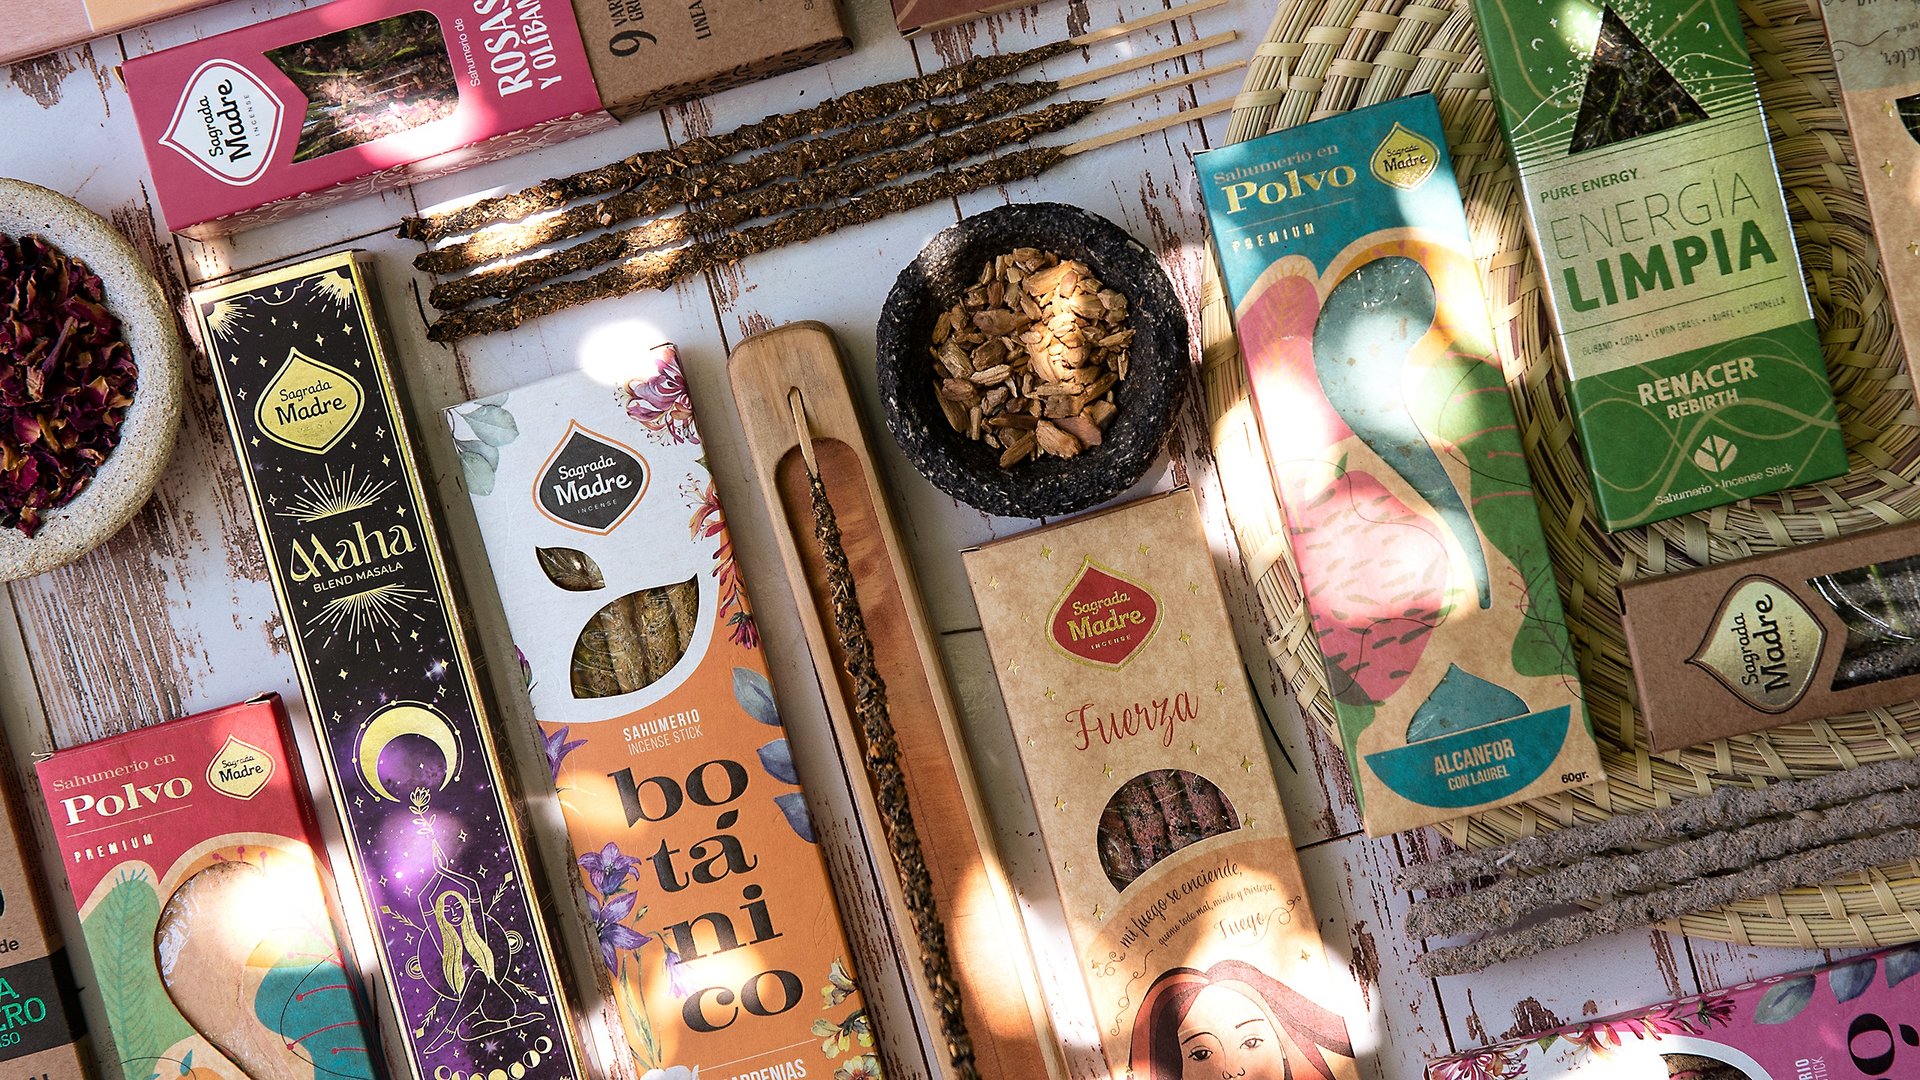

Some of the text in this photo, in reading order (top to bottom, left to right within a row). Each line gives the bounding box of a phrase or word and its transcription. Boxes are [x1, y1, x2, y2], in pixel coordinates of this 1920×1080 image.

[454, 17, 480, 87] Sahumerio de
[473, 0, 533, 98] ROSAS
[609, 30, 657, 57] 9
[538, 75, 562, 91] Y
[197, 95, 224, 157] Sagrada
[217, 79, 252, 163] Madre
[244, 94, 260, 137] INCENSE
[1214, 143, 1340, 185] Sahumerio en
[1383, 154, 1428, 172] Madre
[1220, 164, 1357, 215] Polvo
[1540, 168, 1638, 204] PURE ENERGY
[1550, 168, 1760, 260] ENERGÍA
[1231, 222, 1315, 252] PREMIUM
[1563, 219, 1778, 313] LIMPIA
[1619, 333, 1643, 347] COPAL
[1650, 323, 1676, 340] LEMON
[279, 380, 333, 401] Sagrada
[1637, 357, 1758, 407] RENACER
[275, 396, 347, 426] Madre
[1666, 388, 1740, 420] REBIRTH
[557, 455, 617, 480] Sagrada
[1654, 463, 1794, 507] Sahumerio Incense Stick
[553, 473, 632, 507] Madre
[577, 499, 618, 514] INCENSE
[290, 520, 417, 582] Maha
[313, 562, 404, 593] BLEND MASALA
[1072, 591, 1131, 615] Sagrada
[1066, 609, 1146, 642] Madre
[1090, 634, 1131, 650] INCENSE
[1753, 594, 1791, 693] Madre
[1731, 612, 1760, 685] Sagrada
[623, 708, 701, 742] SAHUMERIO
[1065, 691, 1199, 751] Fuerza
[628, 724, 704, 756] INCENSE STICK
[1434, 738, 1516, 776] ALCANFOR
[52, 753, 176, 793] Sahumerio en
[218, 764, 264, 784] Madre
[221, 755, 255, 769] Sagrada
[1448, 764, 1511, 791] CON LAUREL
[1561, 769, 1590, 784] 60gr.
[60, 777, 193, 827] Polvo
[607, 759, 749, 828] bo
[73, 833, 154, 863] PREMIUM
[646, 809, 758, 893] tá
[1120, 858, 1242, 949] mi fuego se enciende,
[663, 884, 784, 966] ni
[682, 969, 804, 1033] co
[0, 1031, 21, 1048] SO
